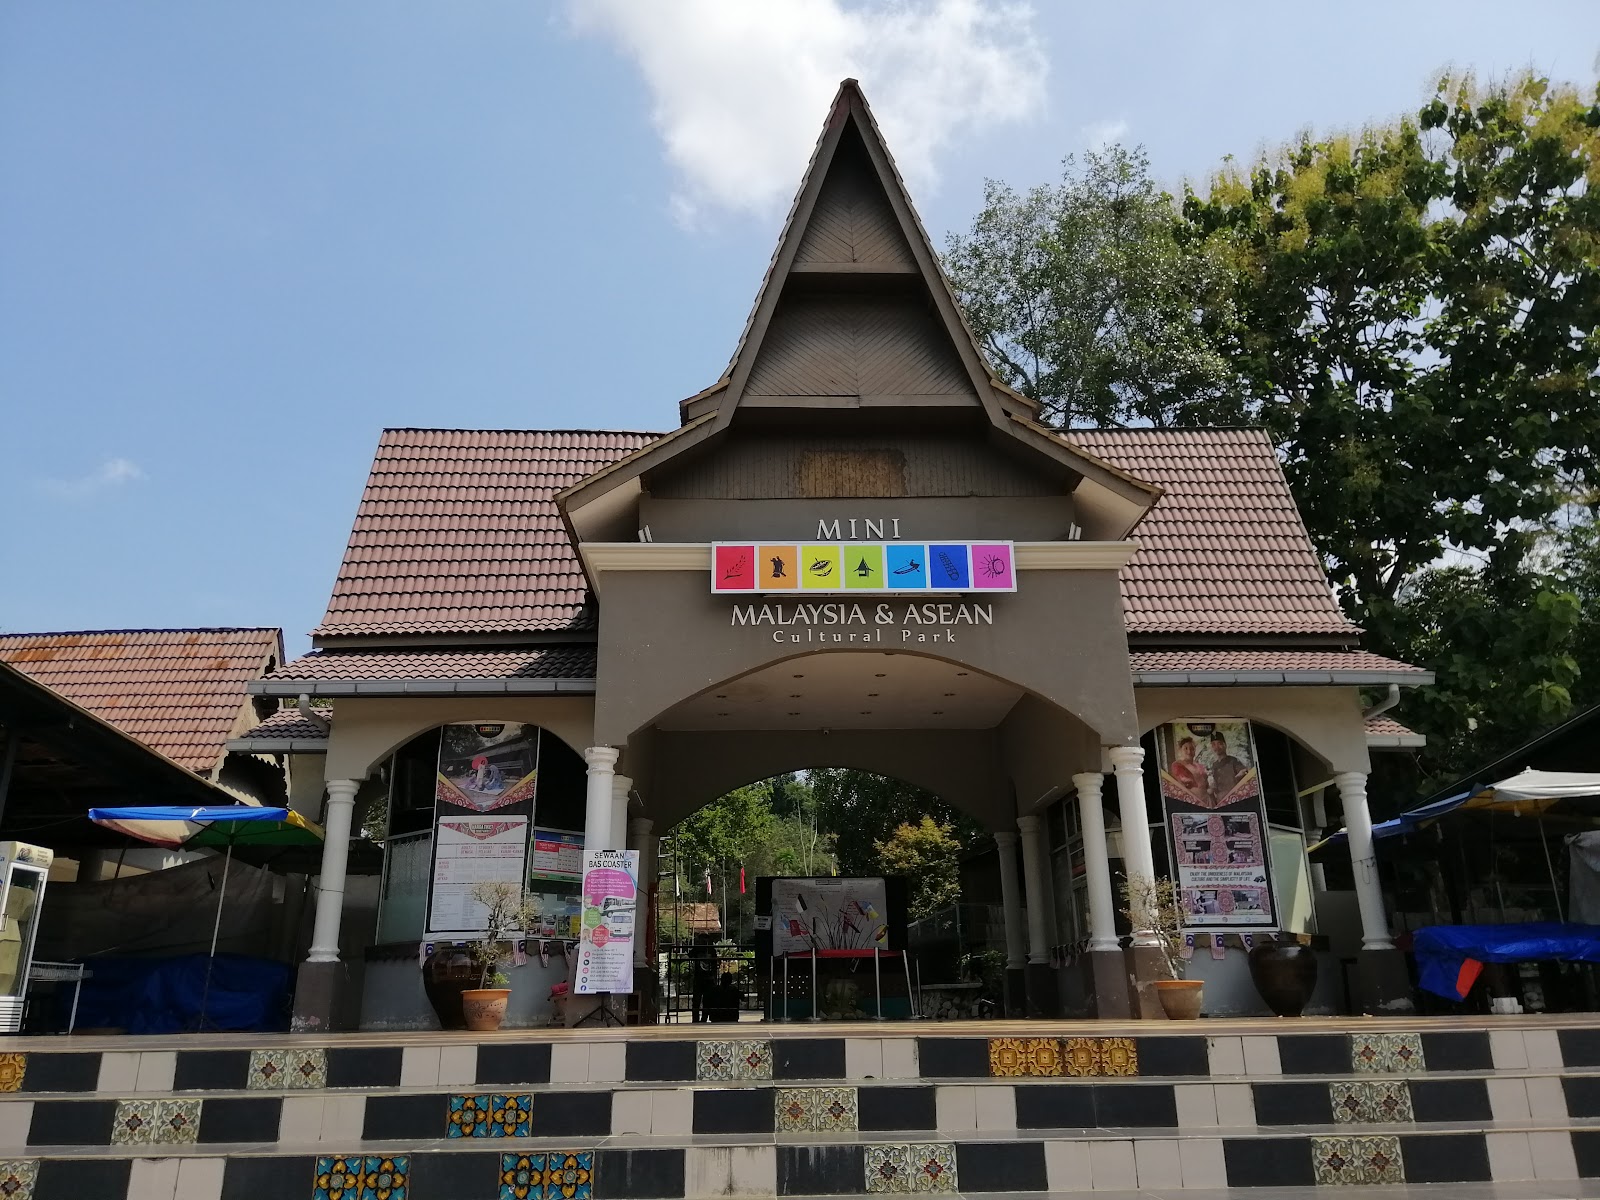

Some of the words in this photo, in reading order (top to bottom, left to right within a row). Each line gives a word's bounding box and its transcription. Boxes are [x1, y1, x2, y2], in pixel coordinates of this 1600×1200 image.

[816, 518, 901, 540] MINI
[731, 603, 868, 626] MALAYSIA
[874, 603, 895, 625] &
[903, 603, 994, 625] ASEAN
[773, 628, 882, 643] Cultural
[901, 629, 956, 643] Park
[589, 860, 602, 868] BAS
[603, 860, 632, 869] COASTER
